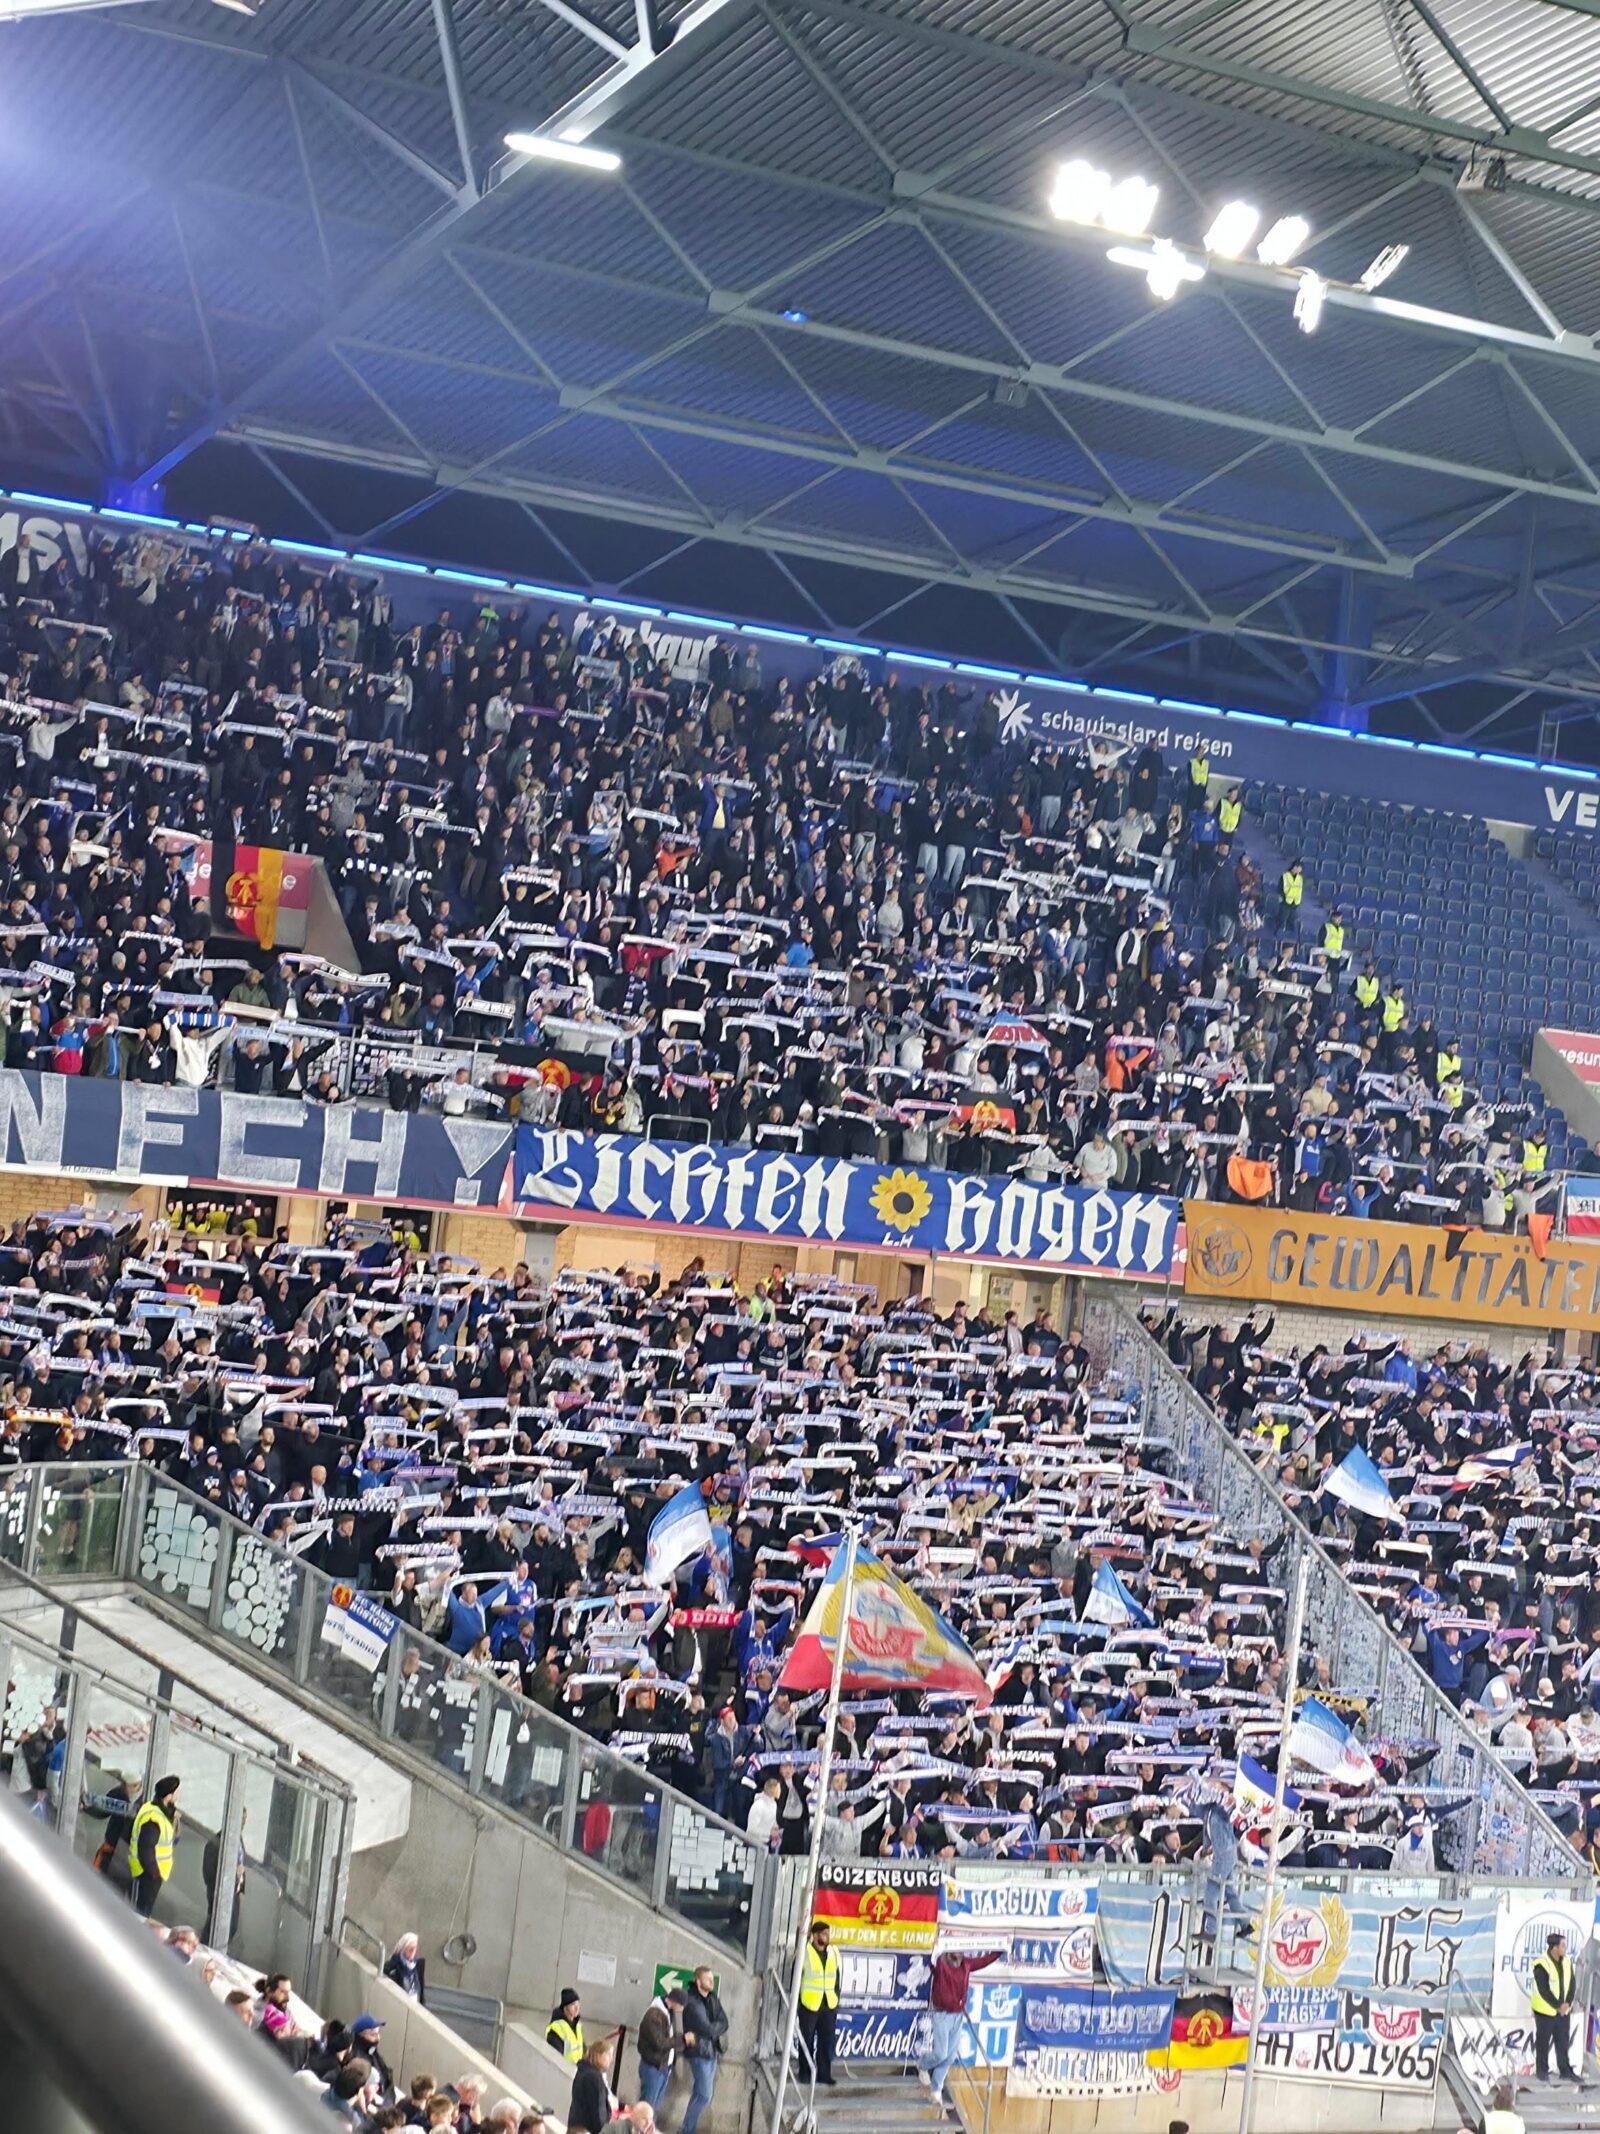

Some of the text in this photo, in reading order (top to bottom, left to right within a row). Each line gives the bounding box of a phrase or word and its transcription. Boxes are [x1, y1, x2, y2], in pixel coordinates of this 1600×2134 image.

[1041, 710, 1233, 758] schauinsland reisen
[520, 1126, 859, 1241] Lichten
[821, 1864, 941, 1888] BOIZENBURG
[971, 1887, 1053, 1916] DARGUN
[1025, 1995, 1171, 2034] GÜSTROW
[1277, 2001, 1328, 2023] HAGEN
[1359, 2036, 1437, 2081] 1965
